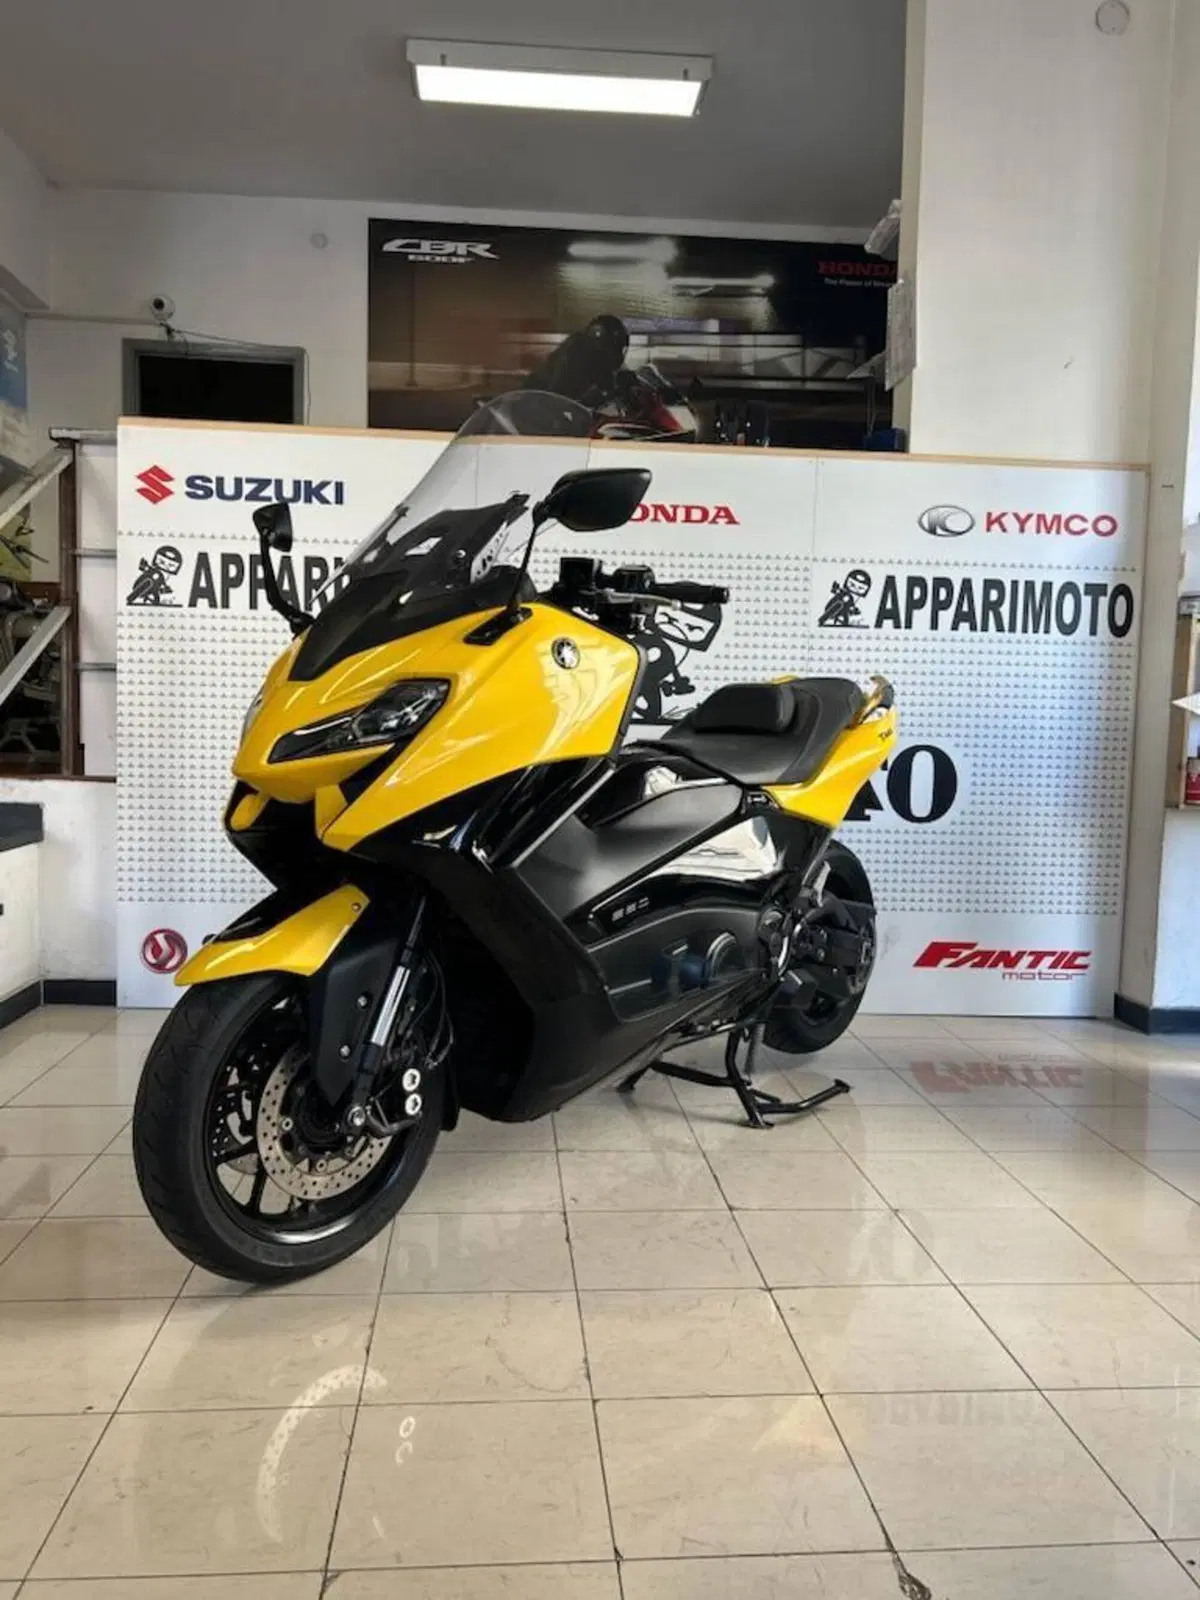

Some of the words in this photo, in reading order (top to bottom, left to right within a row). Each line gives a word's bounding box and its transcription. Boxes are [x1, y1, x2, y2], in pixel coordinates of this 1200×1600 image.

[382, 238, 500, 260] CBR
[184, 475, 344, 505] SUZUKI
[629, 503, 741, 525] ONDA
[985, 511, 1118, 537] KYMCO
[874, 575, 1134, 638] APPARIMOTO
[1001, 970, 1087, 981] motor
